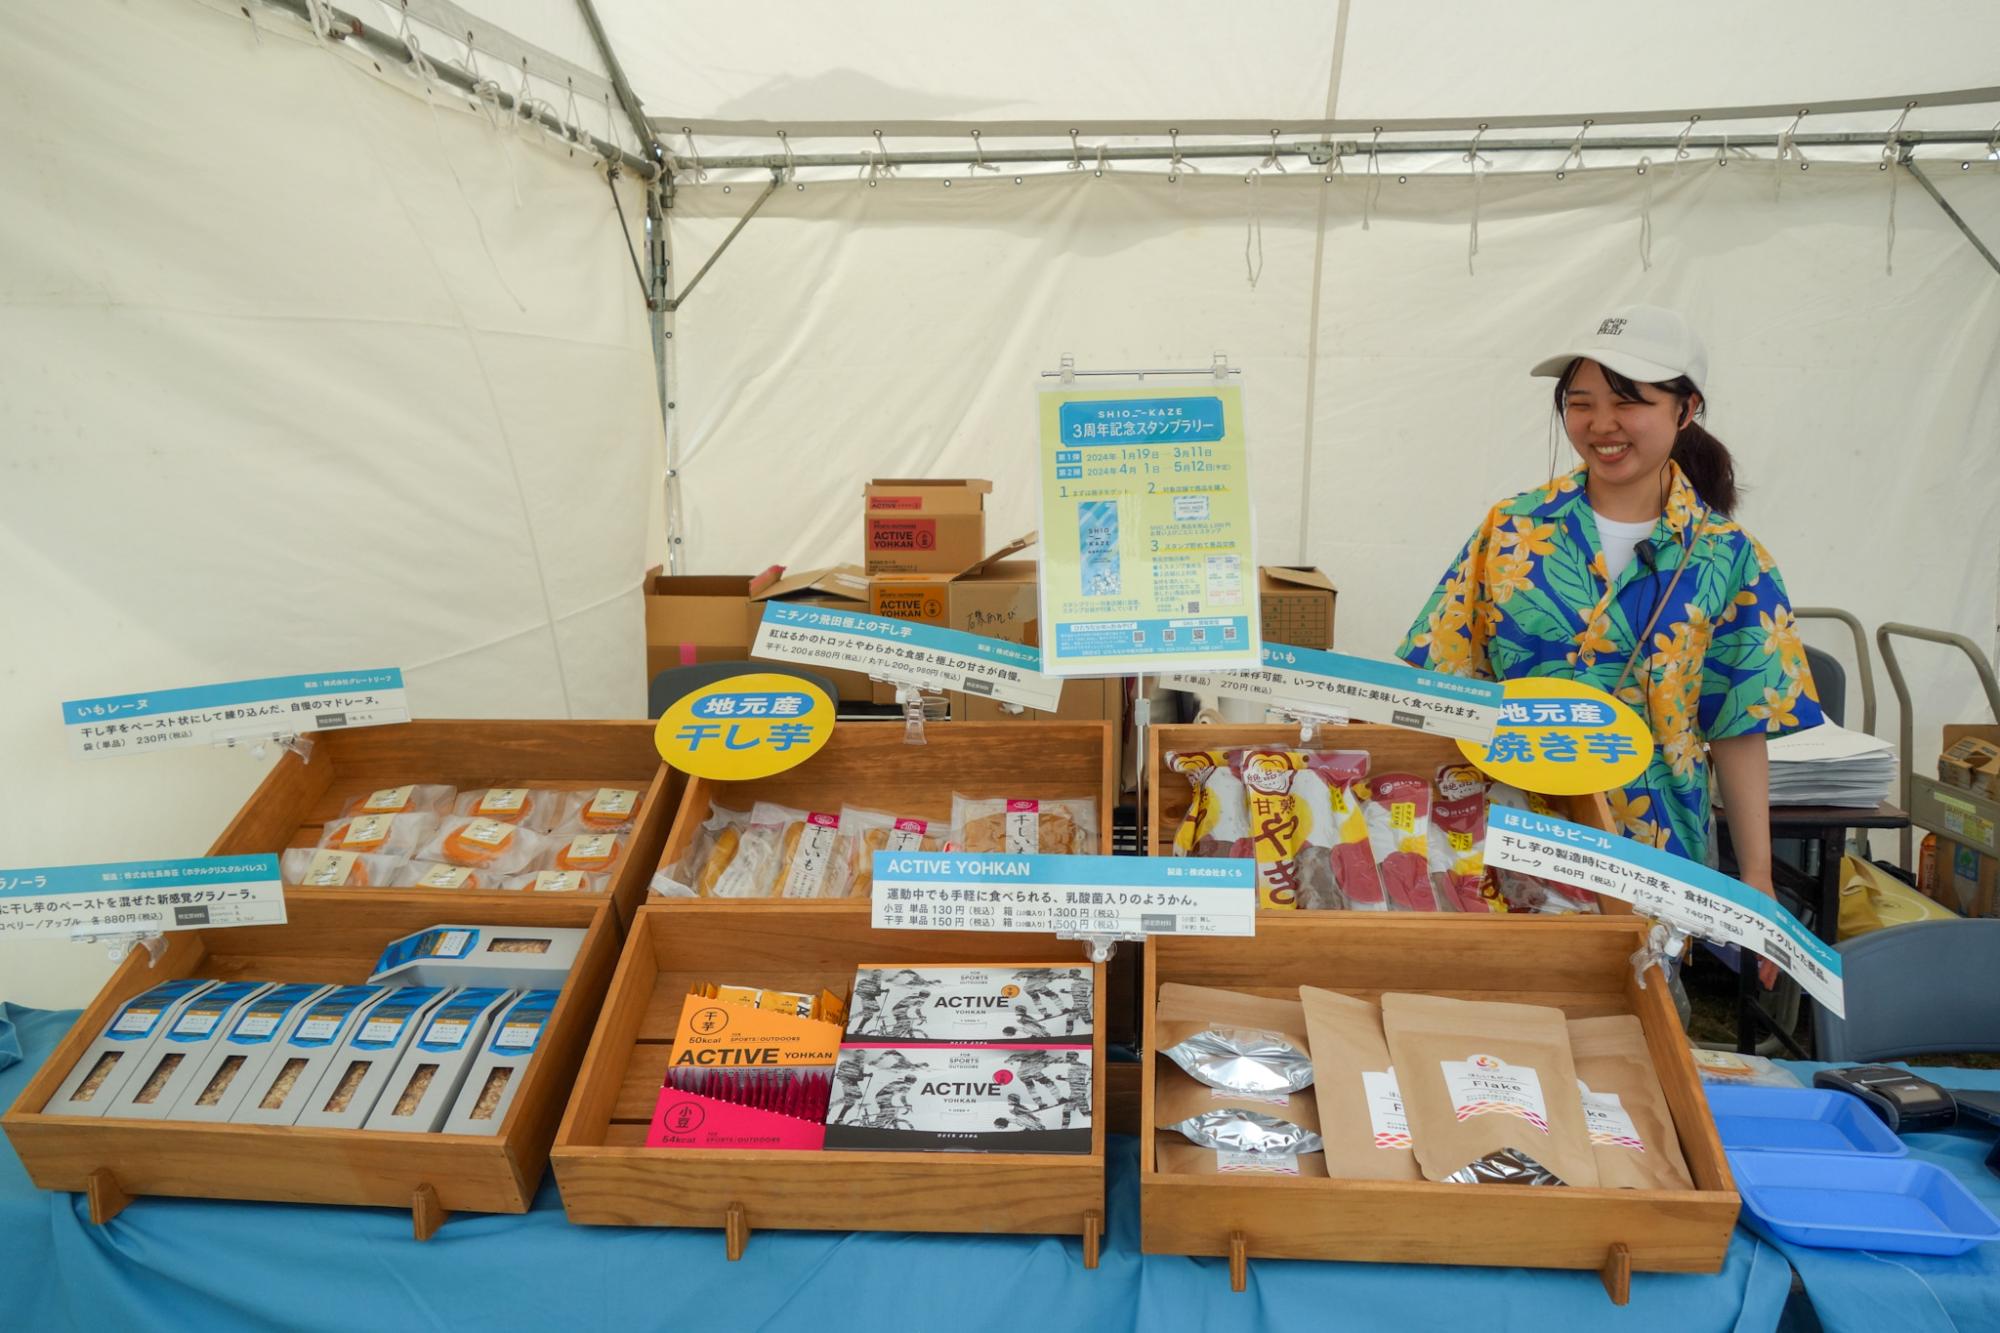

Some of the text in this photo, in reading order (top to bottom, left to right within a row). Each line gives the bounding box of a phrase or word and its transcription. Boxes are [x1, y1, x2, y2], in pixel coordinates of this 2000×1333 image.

[1098, 408, 1184, 418] SHIO KAZE
[1072, 419, 1214, 439] 3周年記念スタンプラリー
[1086, 453, 1117, 462] 2024年
[1087, 468, 1117, 477] 2024年
[1059, 486, 1068, 498] 1
[1147, 482, 1156, 494] 2
[874, 531, 913, 540] ACTIVE
[874, 540, 913, 548] YOHKAN
[1151, 540, 1159, 552] 3
[880, 600, 921, 609] ACTIVE
[881, 610, 921, 618] YOHKAN
[769, 629, 1021, 683] 紅はるかのトロッとやわらかな食感と極上の甘さが自慢。
[78, 699, 149, 717] いもレーヌ
[703, 696, 803, 716] 地元産
[1497, 703, 1605, 724] 地元産
[675, 723, 814, 752] 干し芋
[1481, 732, 1638, 764] 焼き芋
[1504, 813, 1612, 849] ほしいもピール
[804, 826, 828, 871] 干しいも
[888, 859, 1031, 876] ACTIVE YOHKAN
[1500, 852, 1542, 868] フレーク
[887, 887, 1198, 907] 運動中でも手軽に食べられる、乳酸菌入りのようかん。
[884, 904, 904, 914] 小豆
[909, 904, 929, 914] 単品
[884, 915, 904, 925] 干芋
[909, 915, 929, 925] 単品
[934, 996, 1009, 1008] ACTIVE
[702, 1010, 718, 1031] 干芋
[676, 1048, 833, 1065] ACTIVE YOHKAN
[921, 1082, 1001, 1096] ACTIVE
[1473, 1080, 1522, 1092] Flake
[676, 1106, 692, 1128] 小豆
